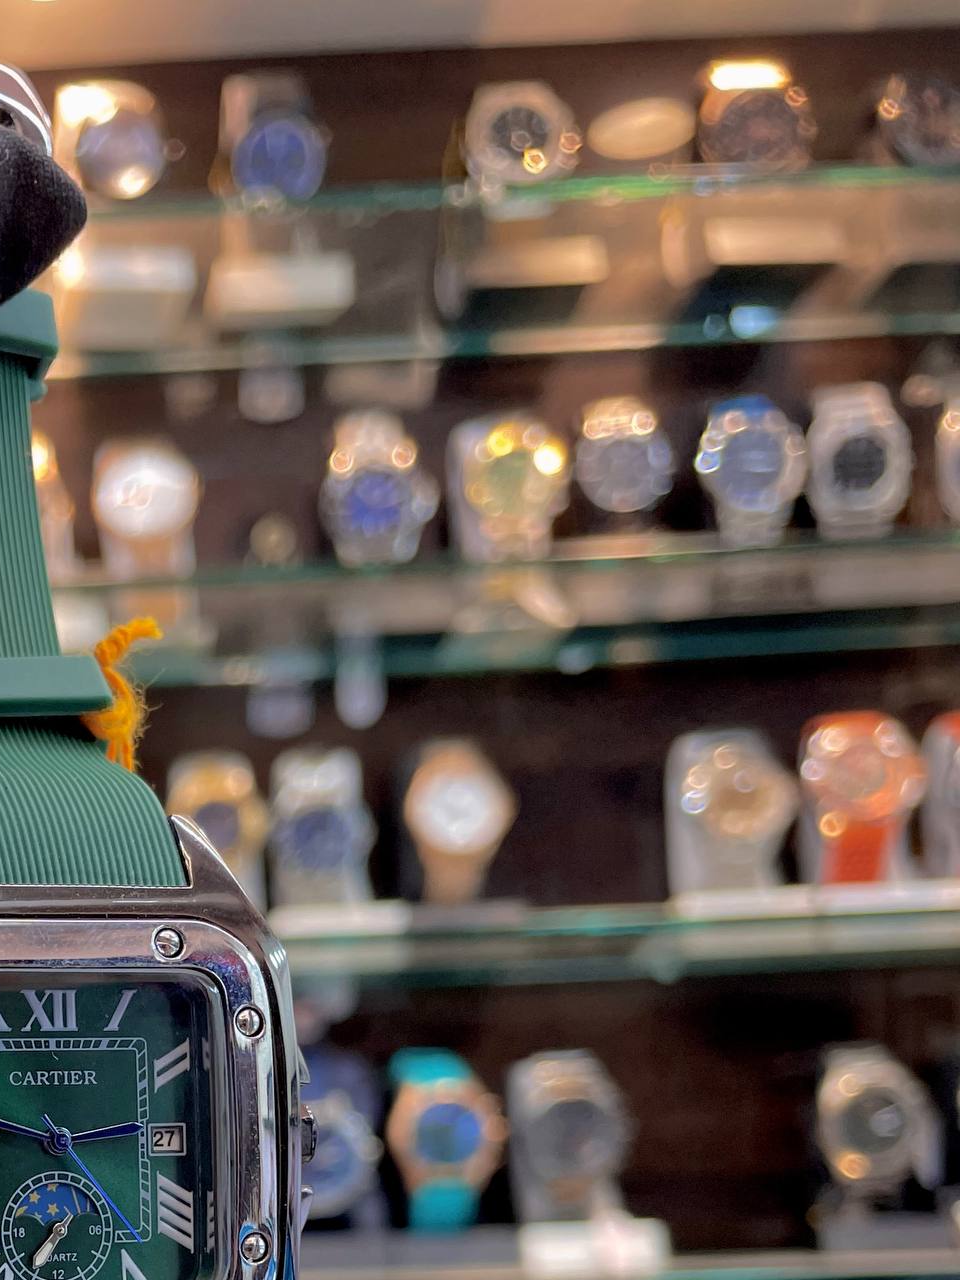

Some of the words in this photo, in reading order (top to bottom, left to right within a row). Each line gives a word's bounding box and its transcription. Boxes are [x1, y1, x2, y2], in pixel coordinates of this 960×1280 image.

[21, 989, 78, 1032] XII
[154, 1038, 190, 1093] II
[9, 1070, 98, 1086] CARTIER
[153, 1130, 175, 1147] 27
[12, 1227, 25, 1238] 18
[88, 1224, 102, 1235] 06
[52, 1269, 65, 1280] 12
